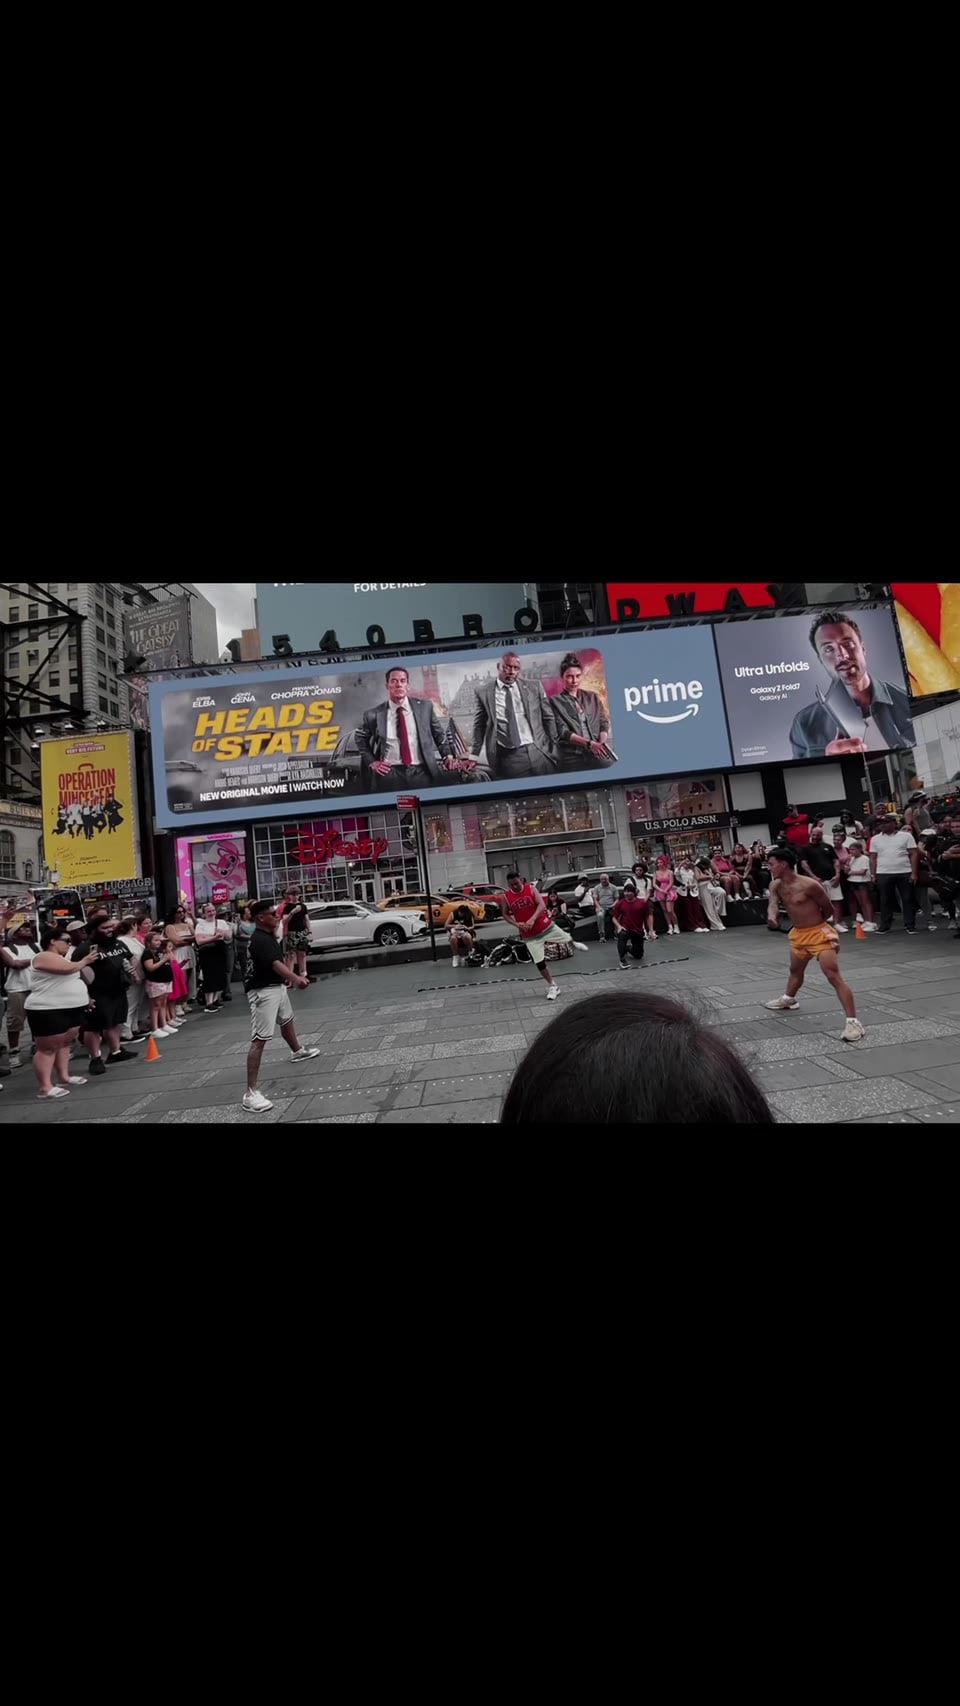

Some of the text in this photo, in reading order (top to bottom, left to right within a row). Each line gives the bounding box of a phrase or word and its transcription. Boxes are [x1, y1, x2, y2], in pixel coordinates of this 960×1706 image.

[354, 583, 378, 592] FOR
[148, 619, 179, 637] GREAT
[137, 632, 176, 654] GATSBY
[734, 661, 810, 678] Ultra Unfolds
[271, 686, 342, 700] CHOPRA JONAS
[624, 677, 703, 711] prime
[750, 685, 776, 694] Galaxy
[782, 683, 800, 691] Fold7
[192, 700, 216, 708] ELBA
[230, 695, 256, 705] CENA
[194, 700, 335, 737] HEADS
[191, 725, 341, 761] OF STATE
[59, 768, 115, 790] OPERATION
[200, 791, 220, 801] NEW
[220, 788, 260, 799] ORIGINAL
[260, 784, 288, 795] MOVIE
[293, 781, 323, 792] WATCH
[323, 778, 345, 789] NOW
[644, 815, 719, 830] U.S. POLO ASSN.
[282, 829, 389, 865] Disney
[74, 877, 151, 893] IFTS LUGGAGE
